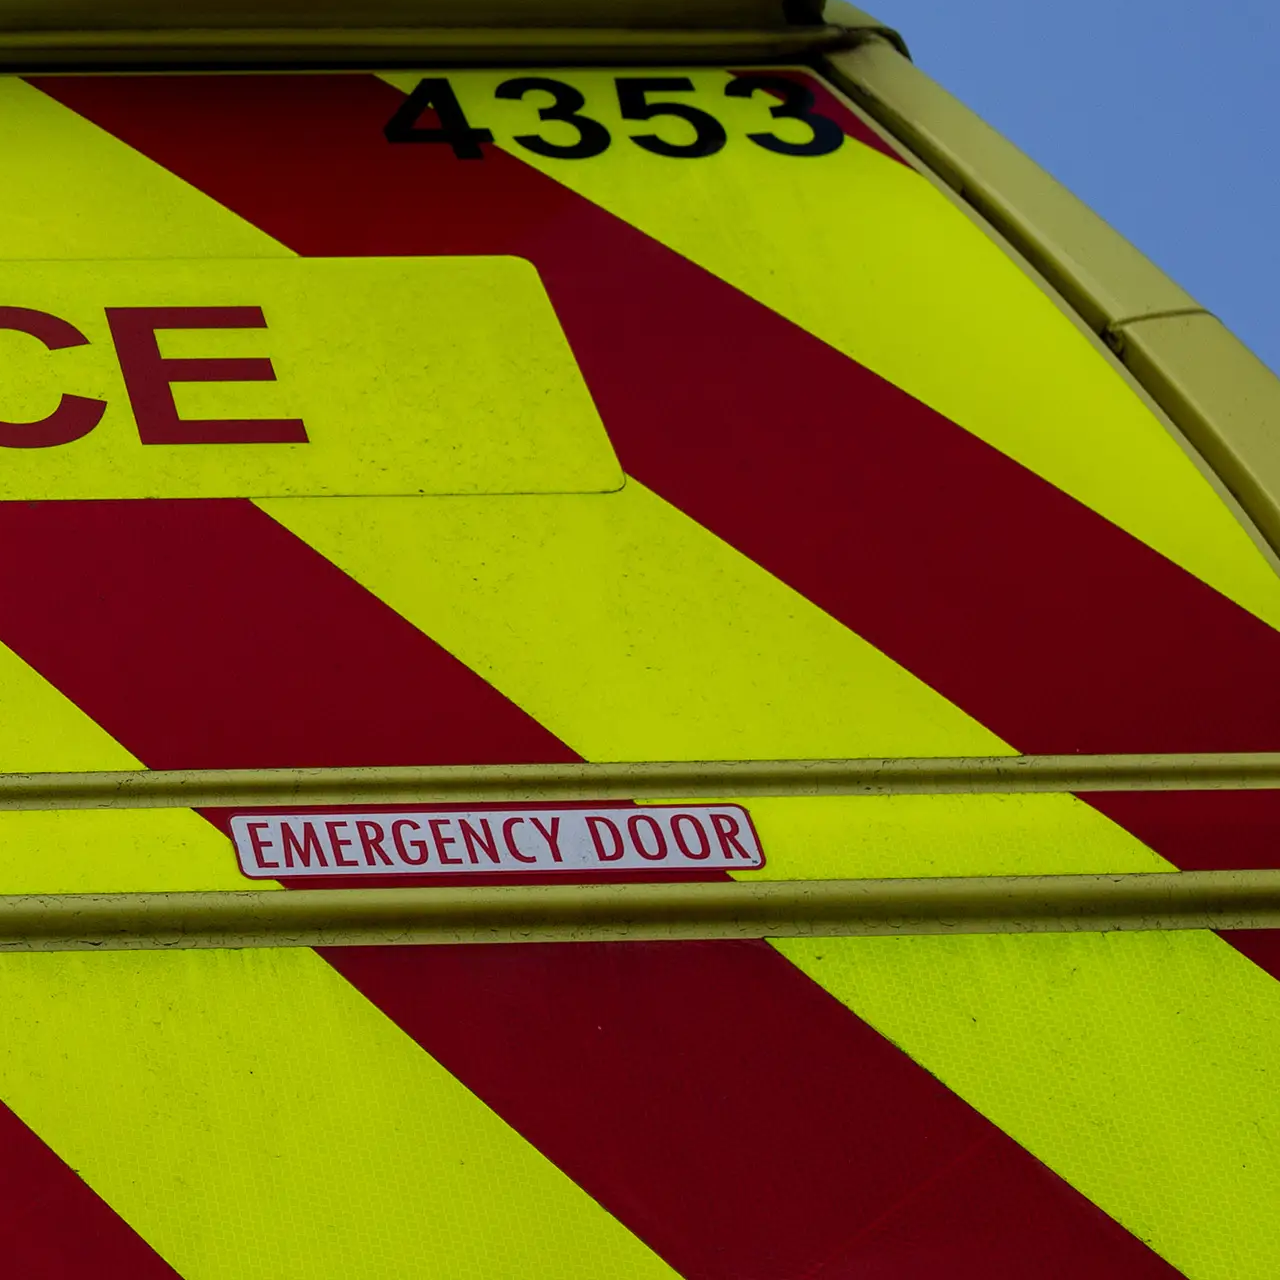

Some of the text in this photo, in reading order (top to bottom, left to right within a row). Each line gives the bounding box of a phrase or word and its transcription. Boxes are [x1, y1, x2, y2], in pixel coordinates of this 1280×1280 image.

[383, 77, 844, 160] 4353
[247, 813, 751, 869] EMERGENCY DOOR
